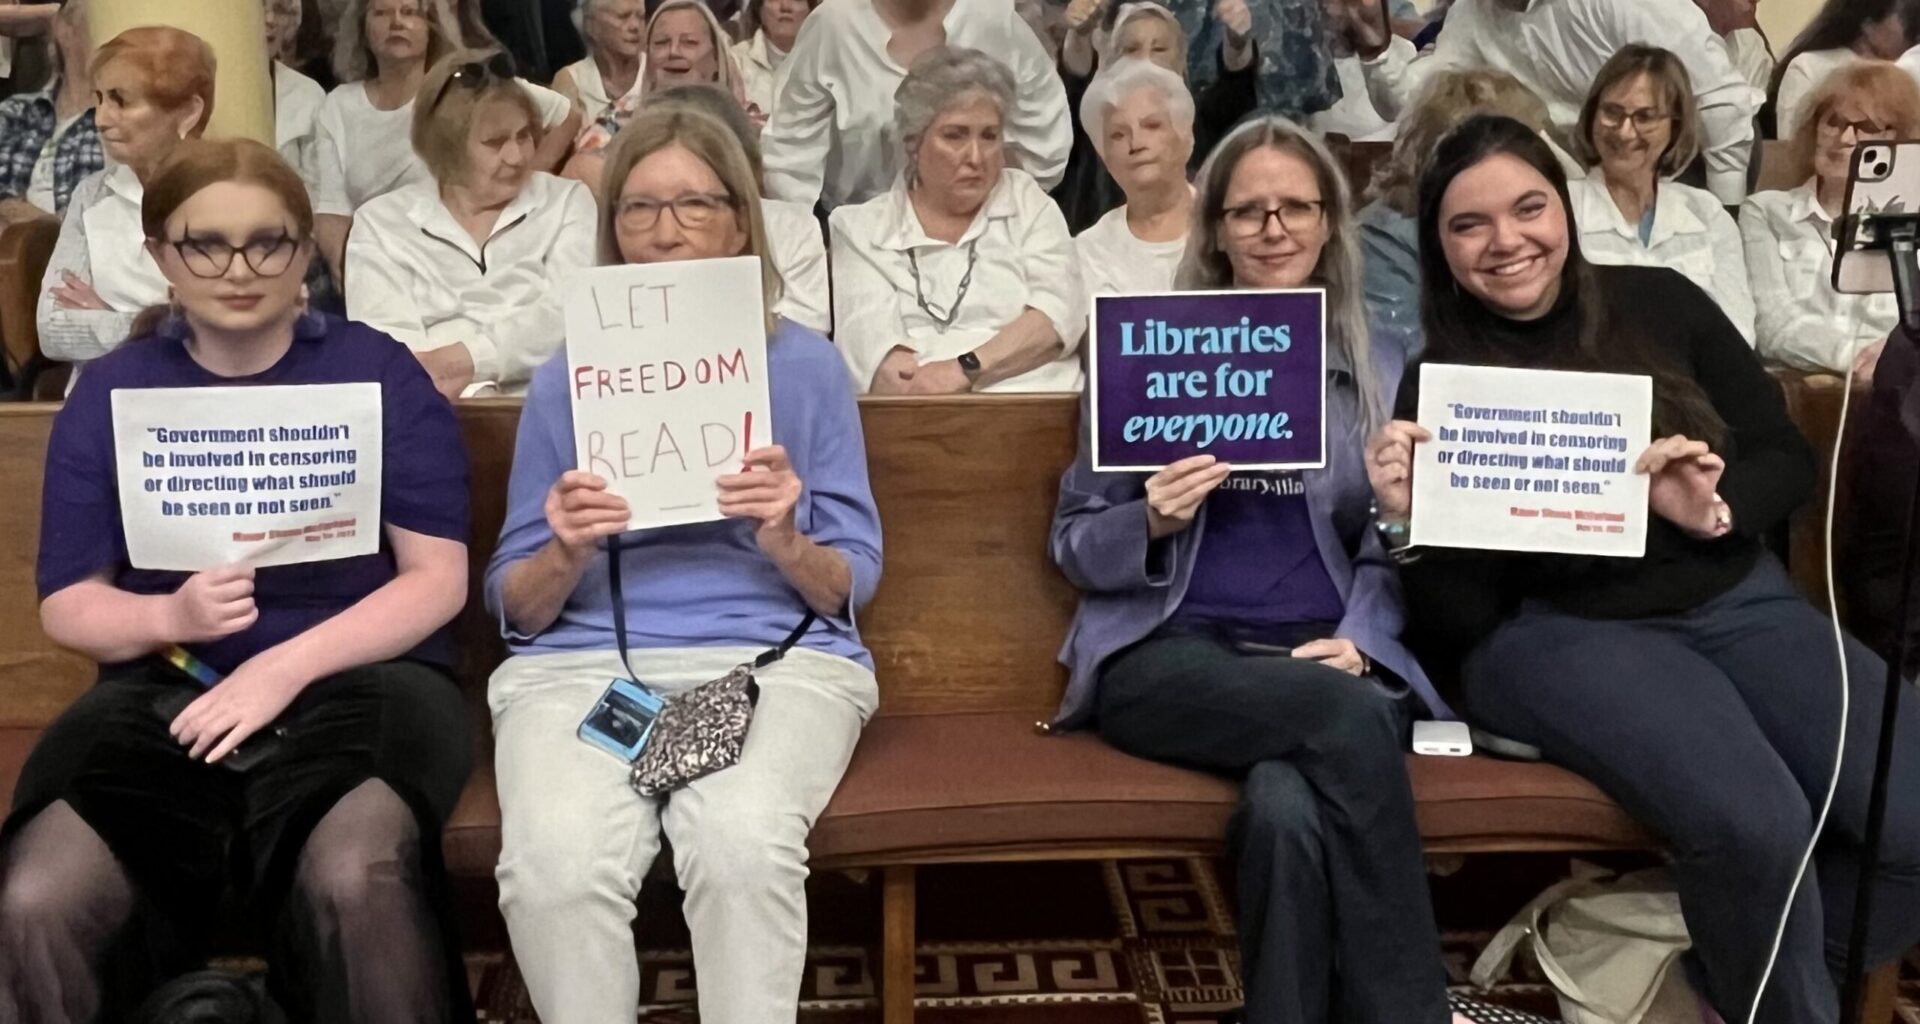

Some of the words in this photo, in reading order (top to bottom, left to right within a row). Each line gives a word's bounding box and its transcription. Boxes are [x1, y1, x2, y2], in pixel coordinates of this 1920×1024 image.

[591, 283, 677, 330] LET
[1120, 316, 1292, 356] Libraries
[574, 348, 749, 400] FREEDOM
[1146, 369, 1208, 399] are
[1214, 362, 1273, 397] for
[1123, 411, 1293, 448] everyone.
[1551, 410, 1621, 427] shouldn't
[269, 424, 350, 442] shouldn't
[1439, 426, 1459, 442] be
[1462, 427, 1528, 445] involved
[1531, 431, 1546, 446] in
[1549, 433, 1627, 452] censoring
[588, 411, 752, 480] READ!
[143, 451, 164, 468] be
[169, 451, 244, 467] involved
[249, 450, 265, 466] in
[269, 449, 357, 465] censoring
[1438, 451, 1453, 464] or
[1457, 450, 1528, 470] directing
[1532, 455, 1570, 471] what
[1573, 456, 1626, 473] should
[144, 478, 162, 493] or
[167, 475, 248, 492] directing
[252, 475, 295, 491] what
[299, 470, 356, 489] should
[1450, 472, 1469, 488] be
[1473, 475, 1511, 490] seen
[1514, 478, 1530, 490] or
[1534, 478, 1559, 492] not
[162, 500, 183, 516] be
[188, 500, 231, 516] seen
[235, 501, 252, 515] or
[257, 499, 285, 514] not
